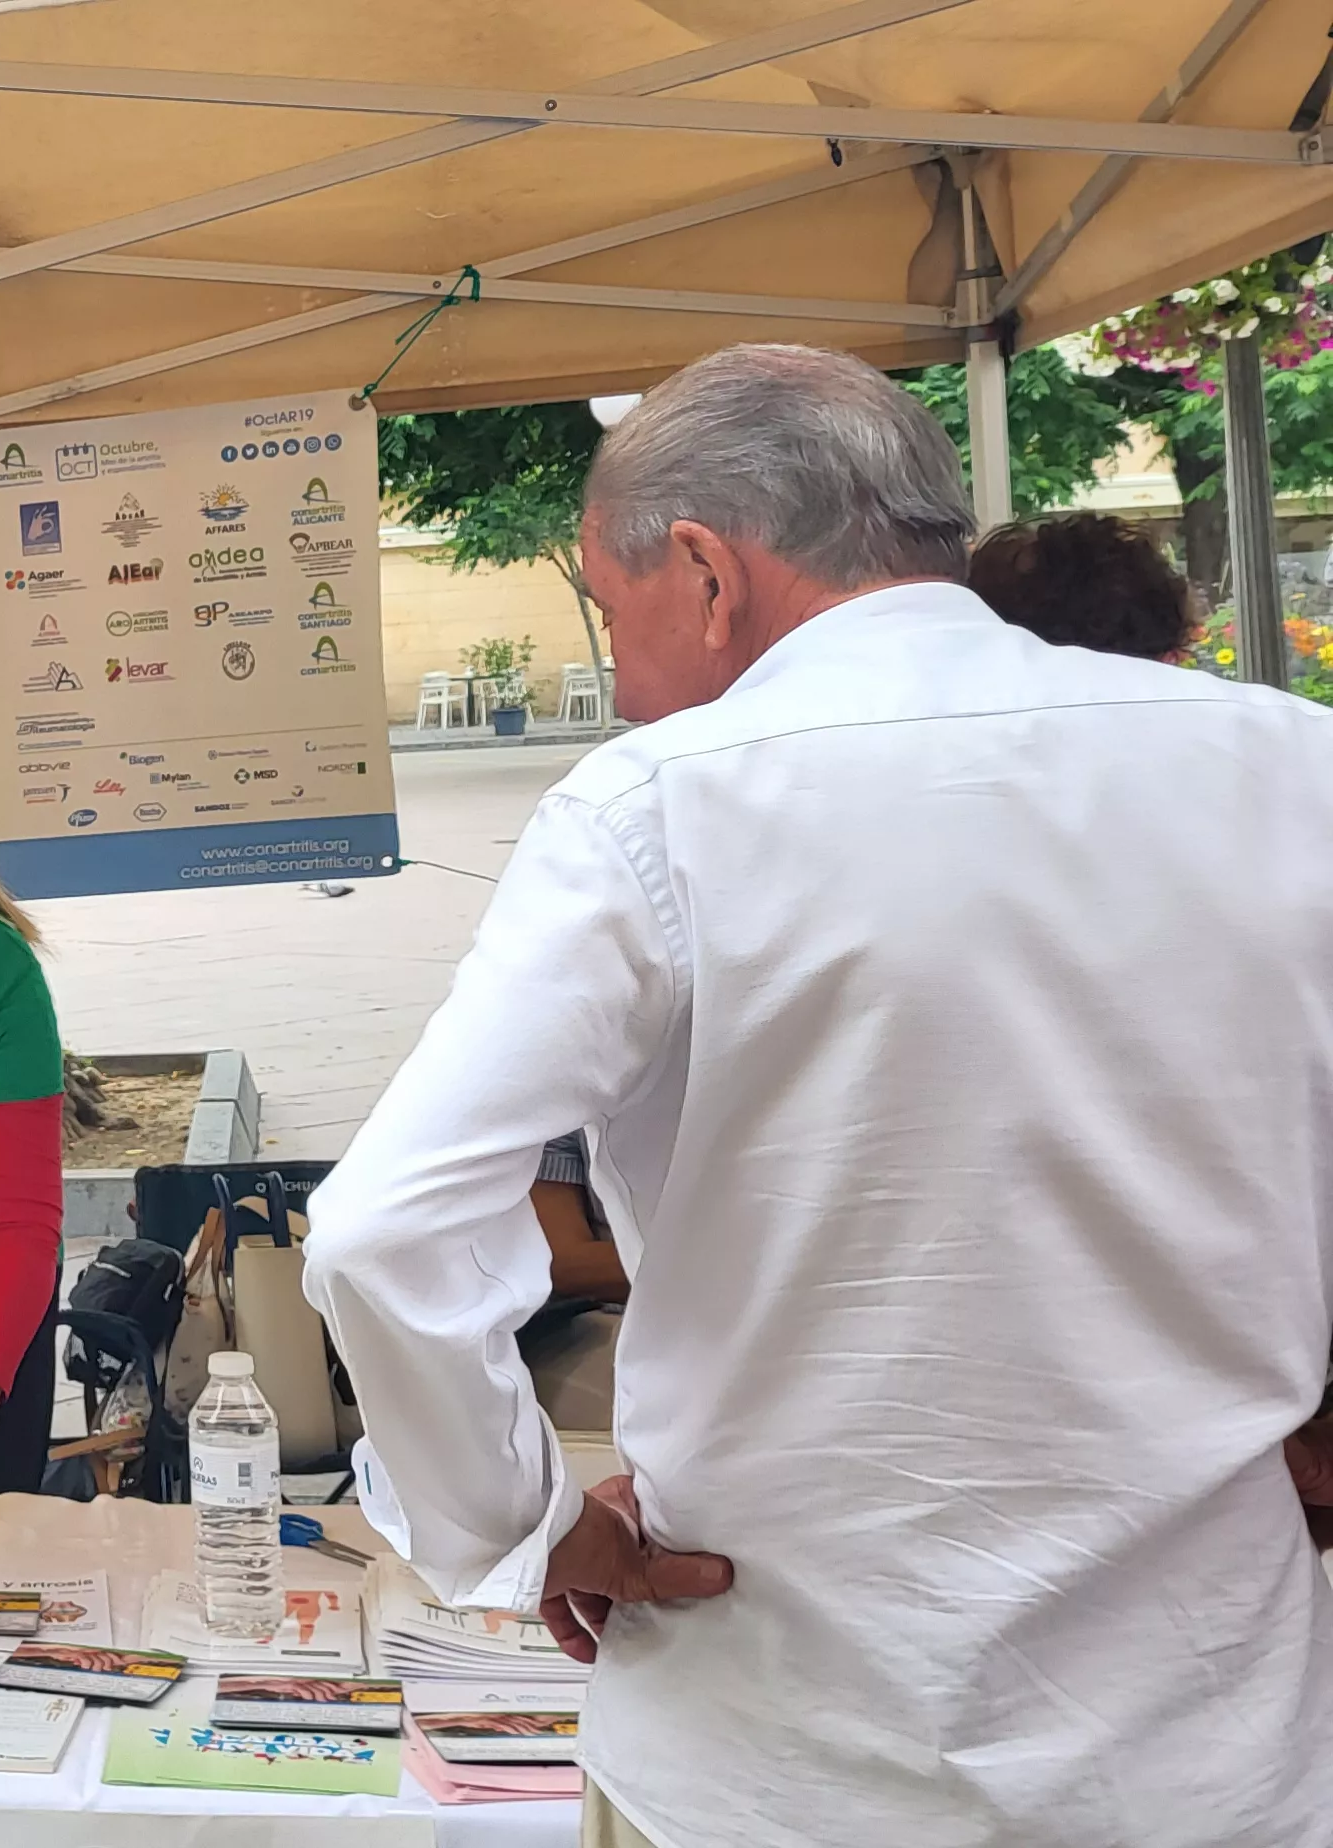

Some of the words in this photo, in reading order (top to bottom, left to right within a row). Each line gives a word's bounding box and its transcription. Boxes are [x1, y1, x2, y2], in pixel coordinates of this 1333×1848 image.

[244, 408, 314, 427] #OctAR19
[100, 441, 158, 456] Octubre,
[60, 461, 94, 476] OCT
[292, 514, 345, 526] ALICANTE
[205, 523, 246, 535] AFFARES
[28, 570, 64, 582] Agaer
[254, 770, 278, 780] MSD
[200, 839, 349, 859] www.conartritis.org
[180, 856, 373, 878] conartritis@conartritis.org
[21, 1578, 94, 1588] artrosis
